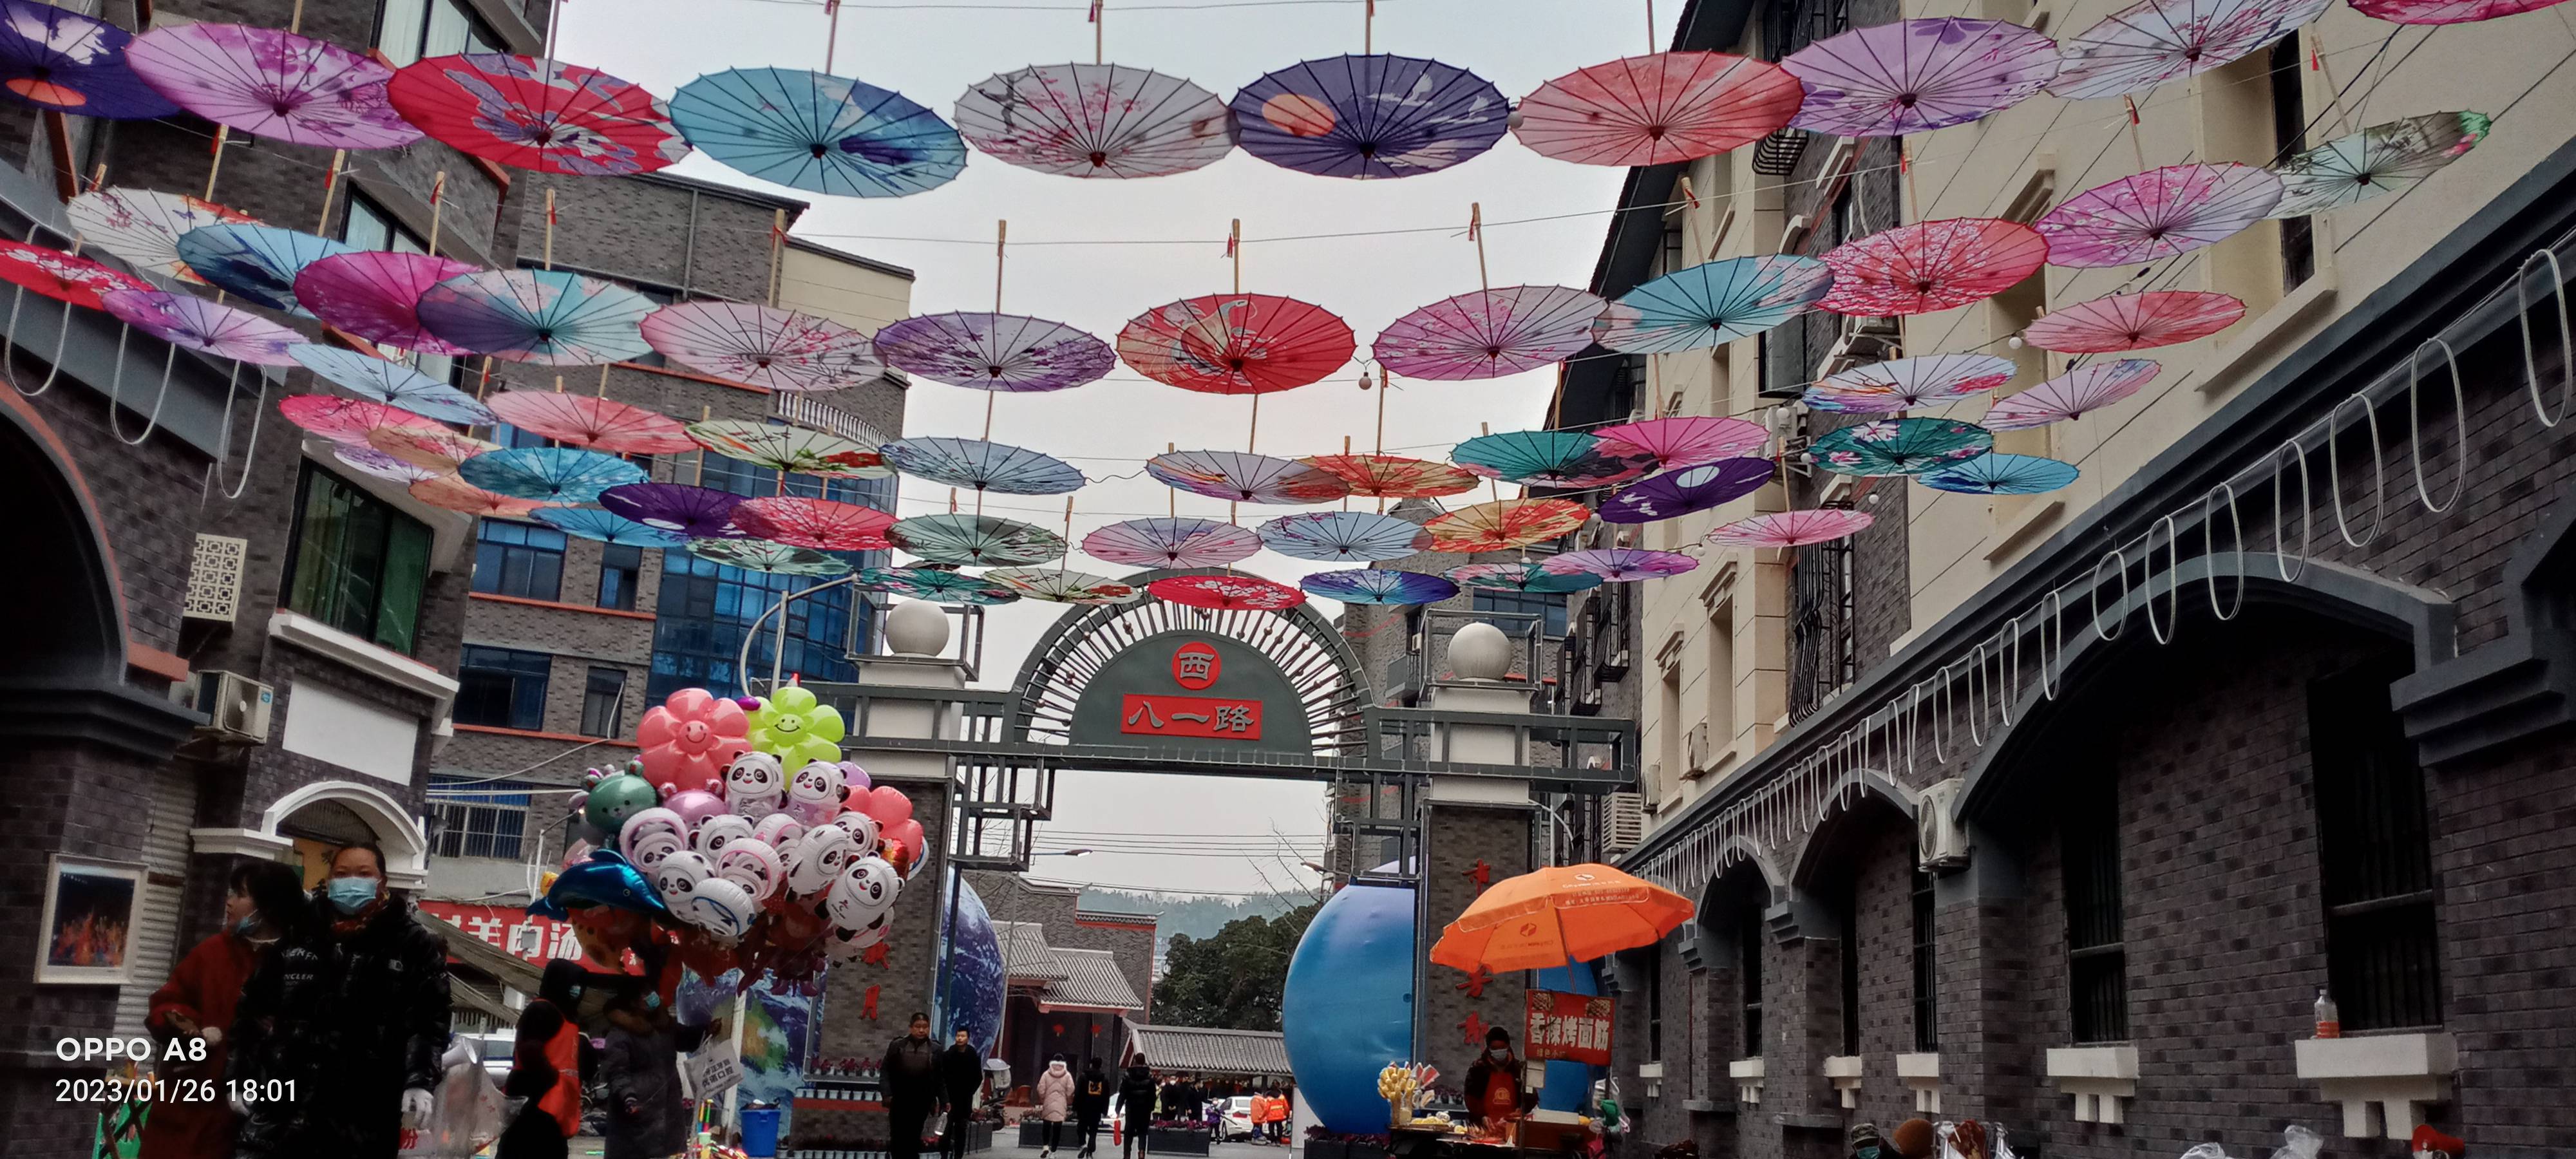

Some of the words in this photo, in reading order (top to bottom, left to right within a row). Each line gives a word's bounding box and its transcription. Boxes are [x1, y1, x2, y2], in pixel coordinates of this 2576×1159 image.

[1179, 653, 1214, 679] 西
[1128, 701, 1254, 731] 八一路
